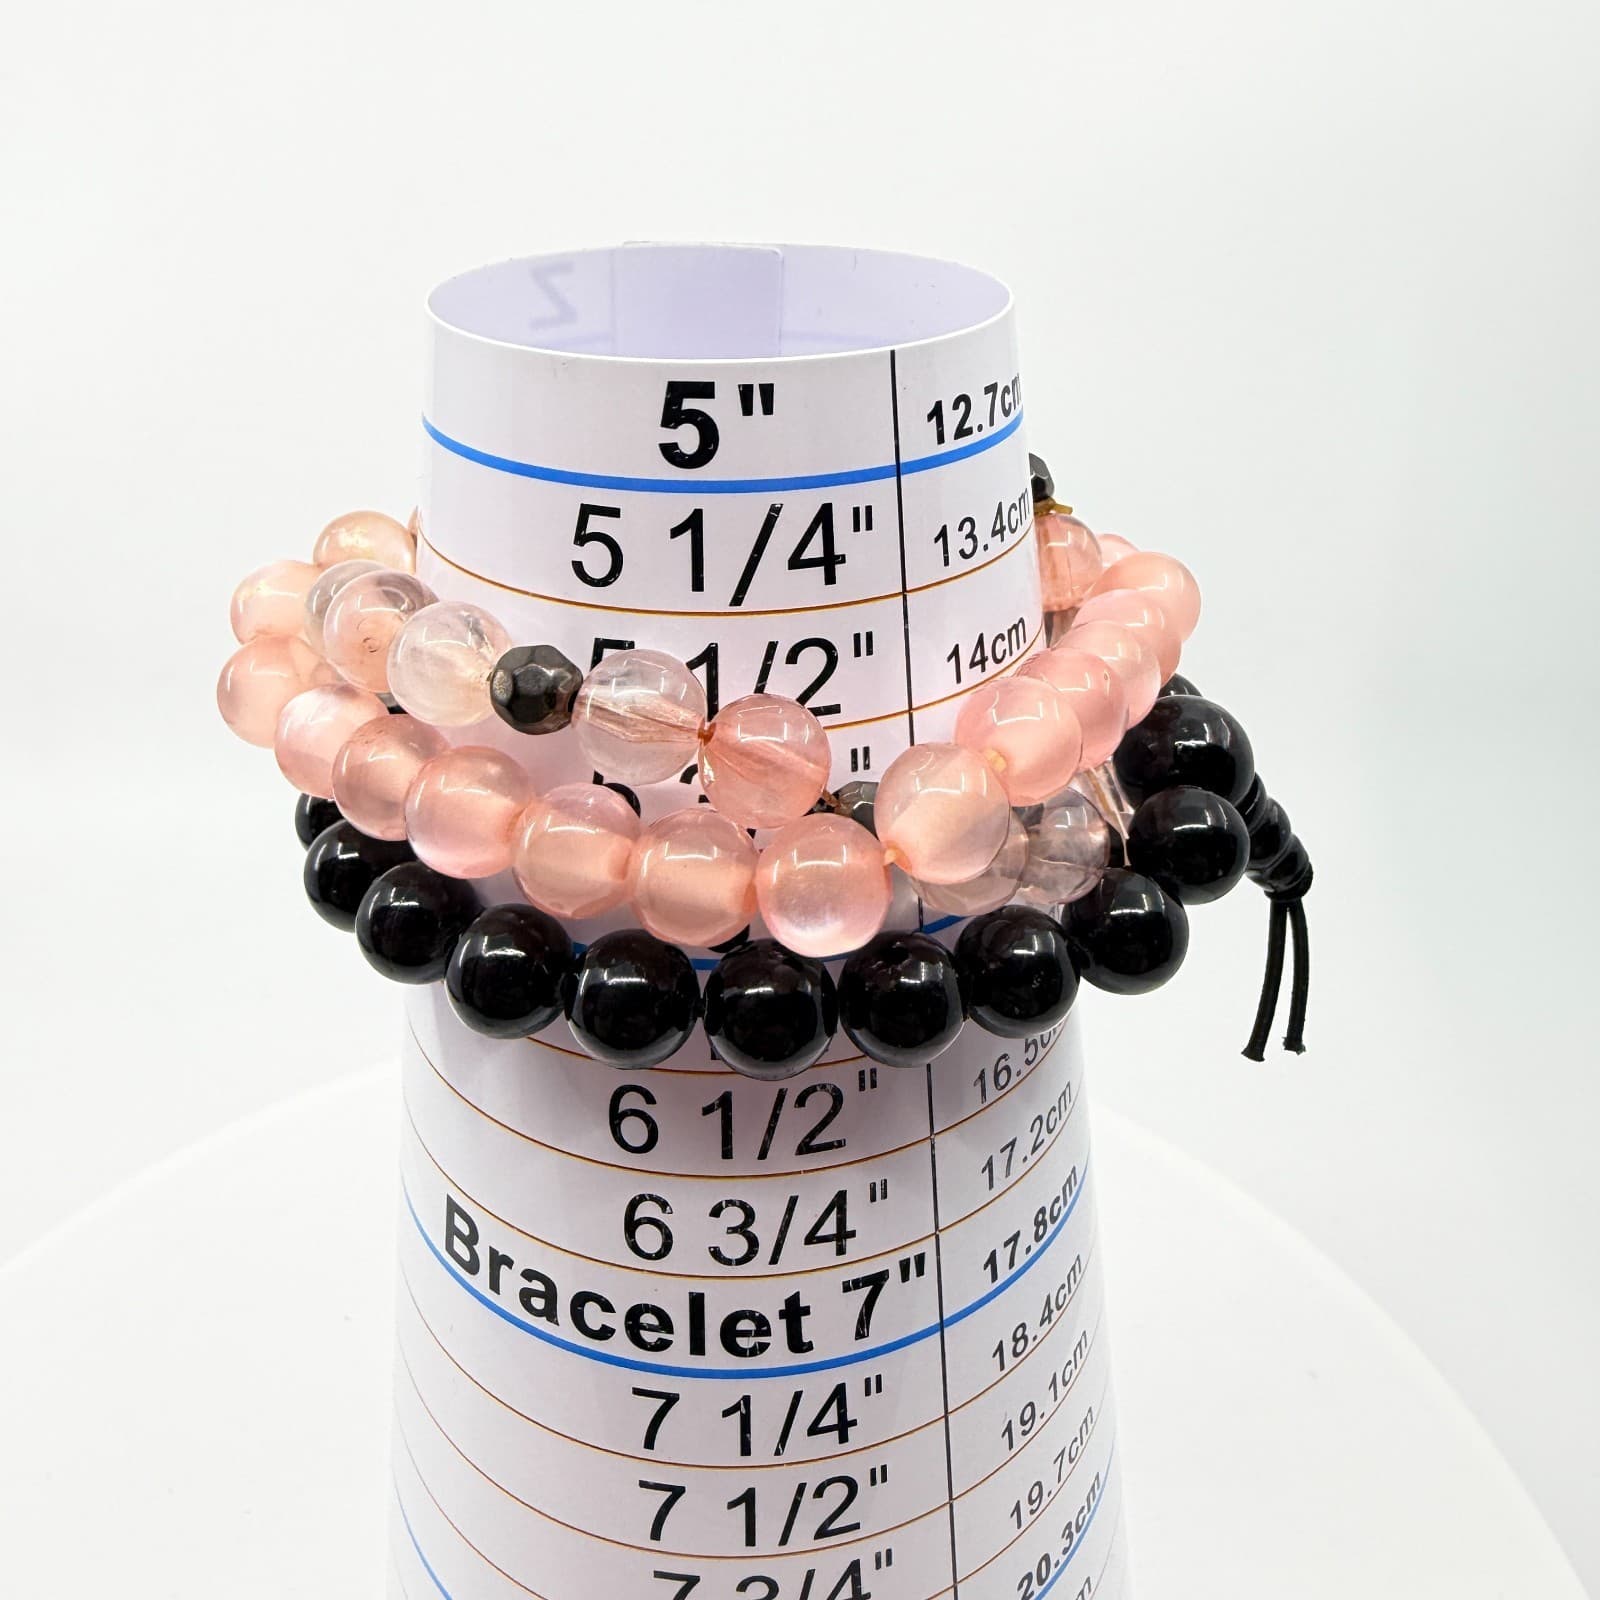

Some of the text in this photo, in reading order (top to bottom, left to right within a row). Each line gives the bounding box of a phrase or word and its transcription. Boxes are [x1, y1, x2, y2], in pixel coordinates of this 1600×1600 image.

[659, 381, 777, 469] 5"
[572, 503, 873, 607] 5 1/4"
[934, 487, 1030, 567] 13.4cm
[947, 617, 1027, 684] 14cm
[608, 1067, 878, 1160] 6 1/2"
[981, 1081, 1072, 1191] 17.2cm
[624, 1178, 888, 1267] 6 3/4"
[983, 1166, 1077, 1284] 17.8cm
[444, 1194, 926, 1358] Bracelet 7"
[991, 1254, 1082, 1372] 18.4cm
[632, 1374, 883, 1456] 7 1/4"
[1001, 1329, 1088, 1451] 19.1cm
[638, 1464, 888, 1547] 7 1/2"
[1009, 1405, 1094, 1530] 19.7cm
[1016, 1471, 1101, 1600] 20.3cm
